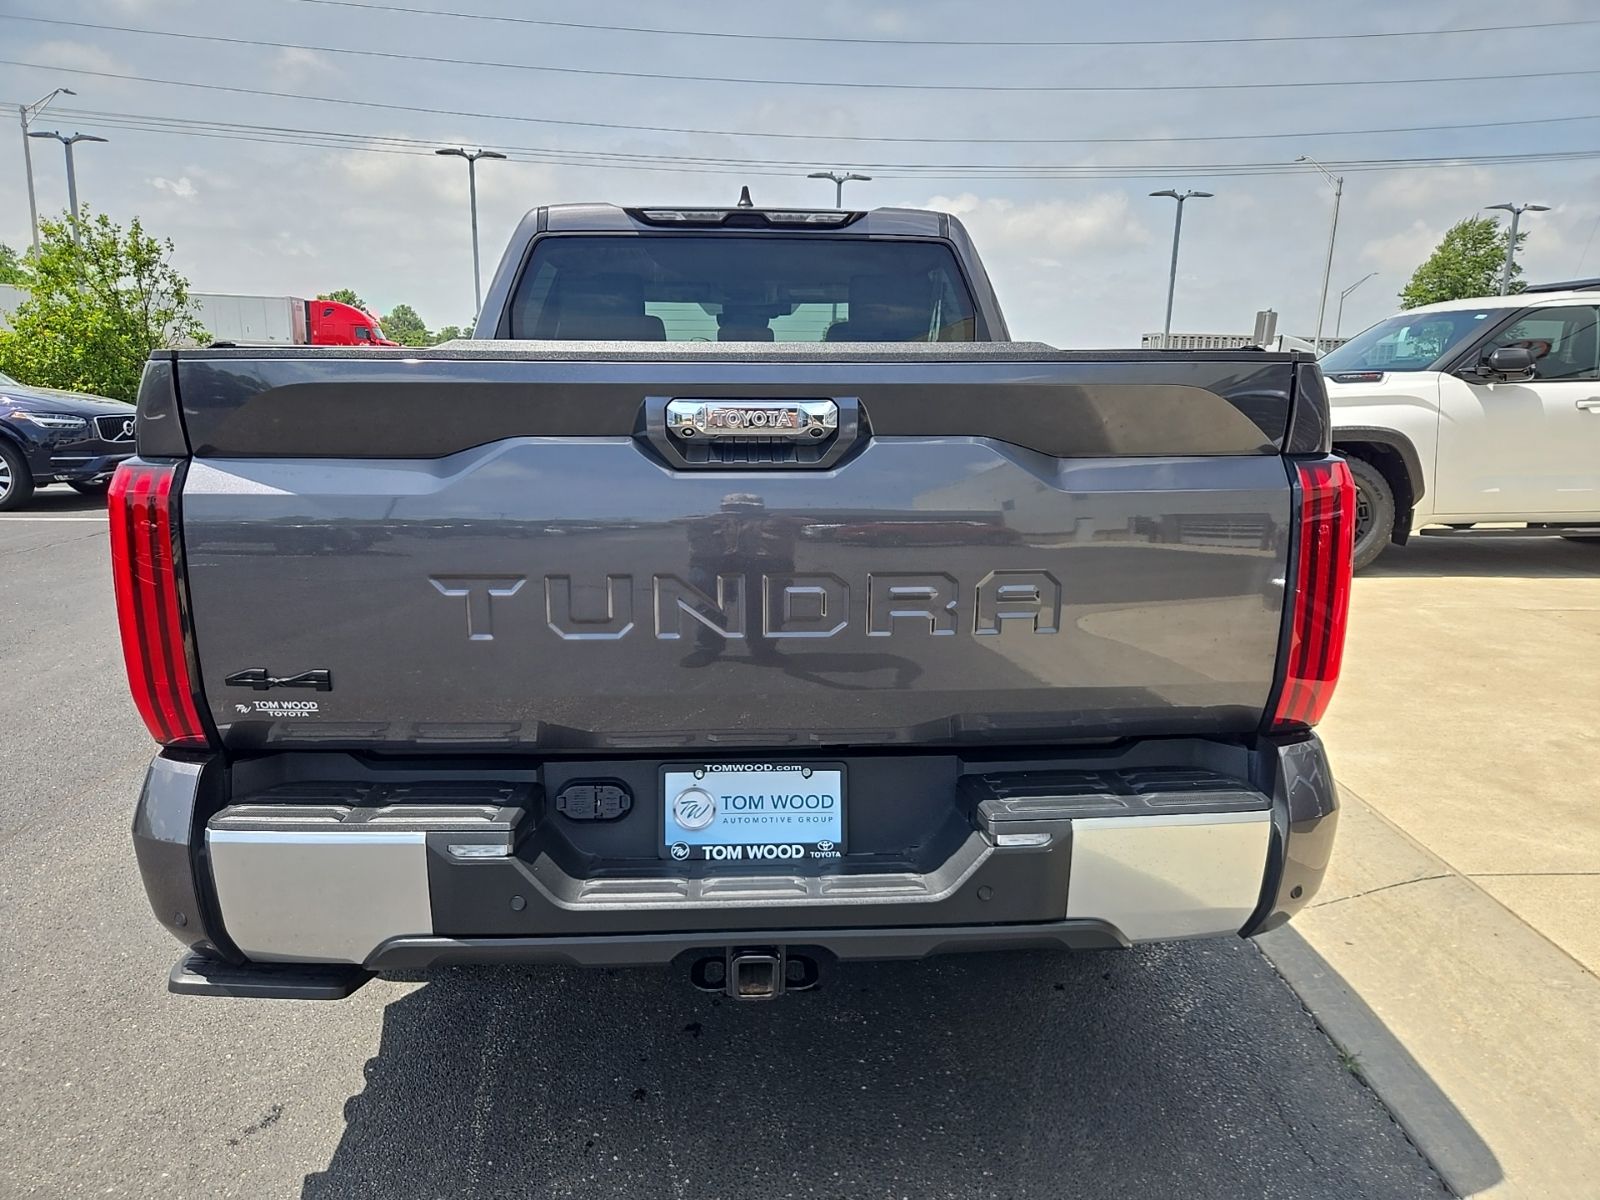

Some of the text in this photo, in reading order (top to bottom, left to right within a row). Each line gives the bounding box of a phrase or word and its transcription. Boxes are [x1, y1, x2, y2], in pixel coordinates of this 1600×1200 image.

[713, 409, 792, 428] TOYOTA
[428, 568, 1063, 642] TUNDRA
[253, 701, 318, 710] TOM WOOD
[704, 764, 802, 772] TOMWOOD.com
[721, 794, 834, 810] TOM WOOD
[723, 816, 792, 824] AUTOMOTIVE
[702, 844, 805, 860] TOM WOOD
[810, 851, 842, 859] TOYOTA
